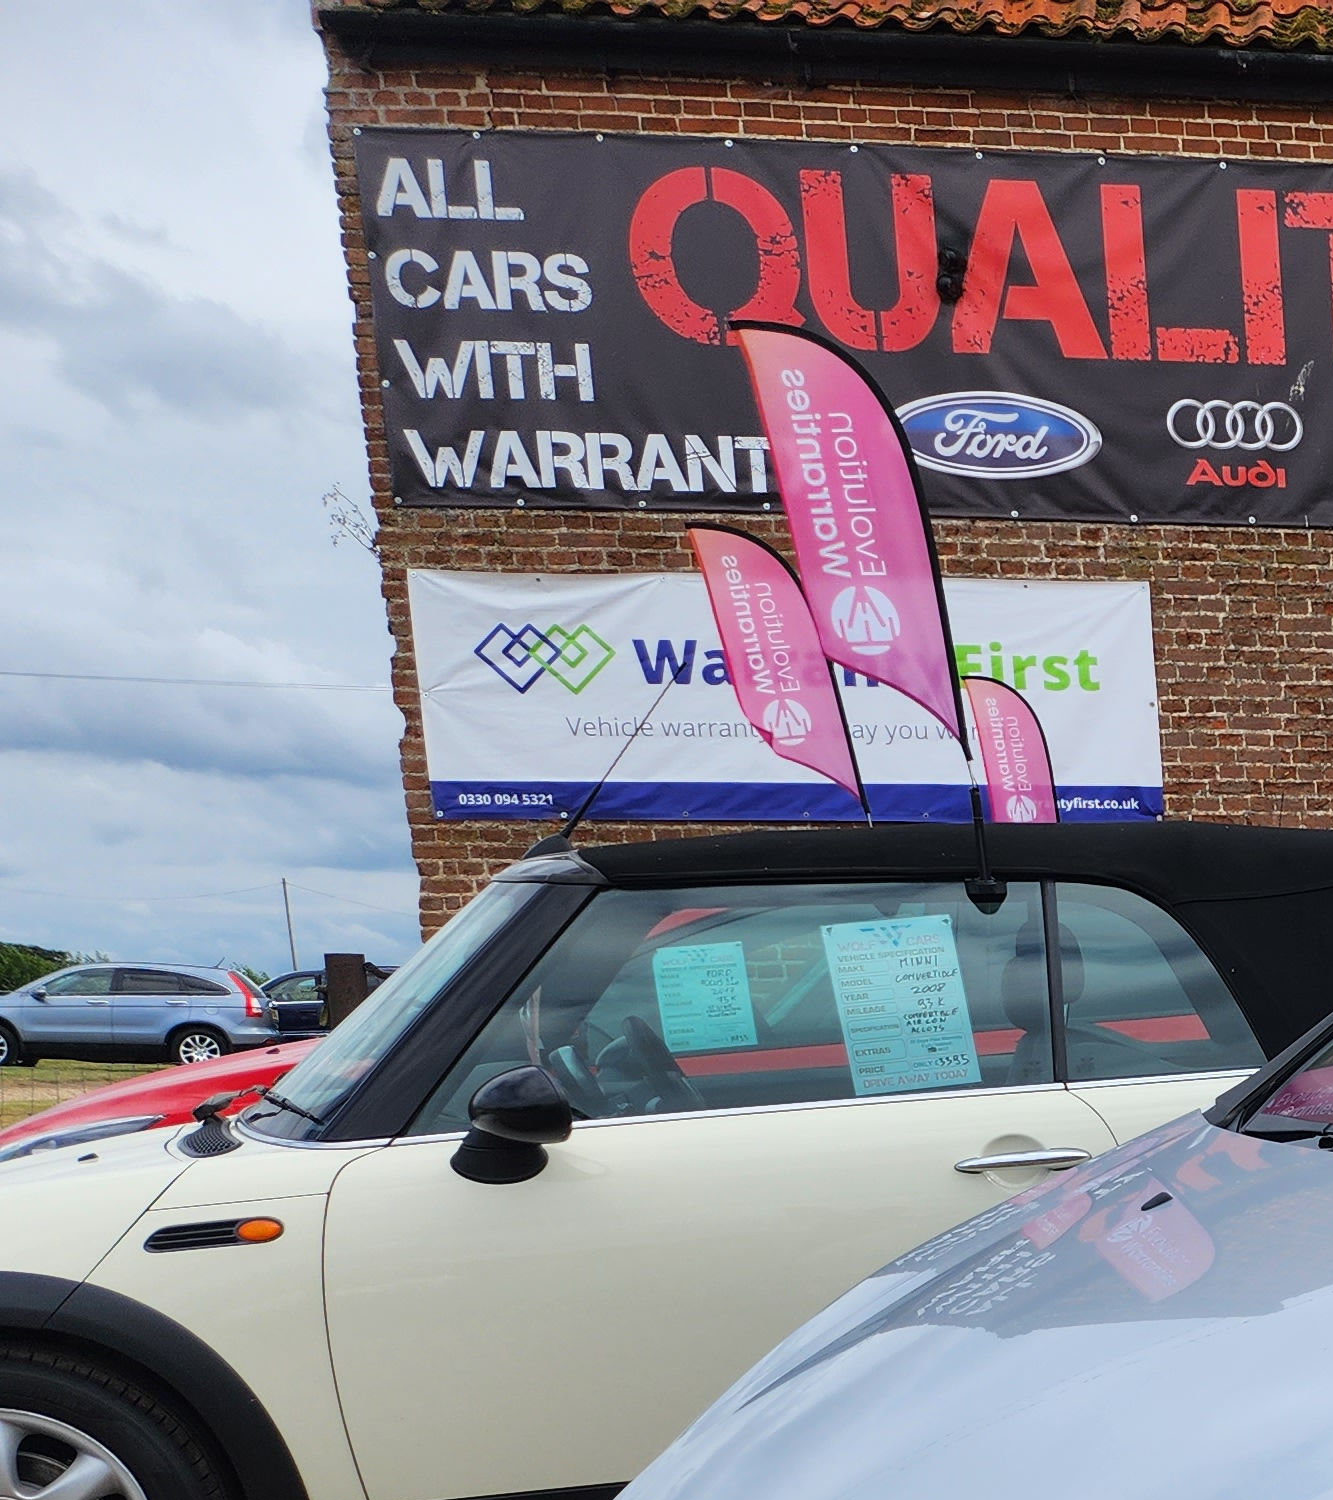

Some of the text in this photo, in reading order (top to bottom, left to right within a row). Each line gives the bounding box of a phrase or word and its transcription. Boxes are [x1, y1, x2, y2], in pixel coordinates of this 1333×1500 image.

[376, 157, 524, 221] ALL
[384, 248, 592, 312] CARS
[393, 339, 595, 401] WITH
[934, 408, 1048, 461] Ford
[403, 428, 771, 494] WARRANT
[1186, 459, 1288, 489] Audi
[566, 716, 654, 738] Vehicle
[661, 719, 765, 743] warrant
[852, 725, 878, 744] ay
[885, 725, 929, 745] you
[458, 792, 554, 806] 0330 094 5321
[1057, 797, 1139, 812] tyfirst.co.uk
[836, 934, 940, 951] WOLF CARS
[837, 946, 945, 963] VEHICLE SPECIFICATION
[838, 964, 865, 974] MAKE
[841, 978, 873, 988] MODEL
[843, 983, 946, 1001] YEAR 2008
[846, 1005, 886, 1016] MILEAGE
[855, 1047, 891, 1057] EXTRAS
[858, 1065, 885, 1074] PRICE
[863, 1069, 969, 1089] DRIVE AWAY TODAY
